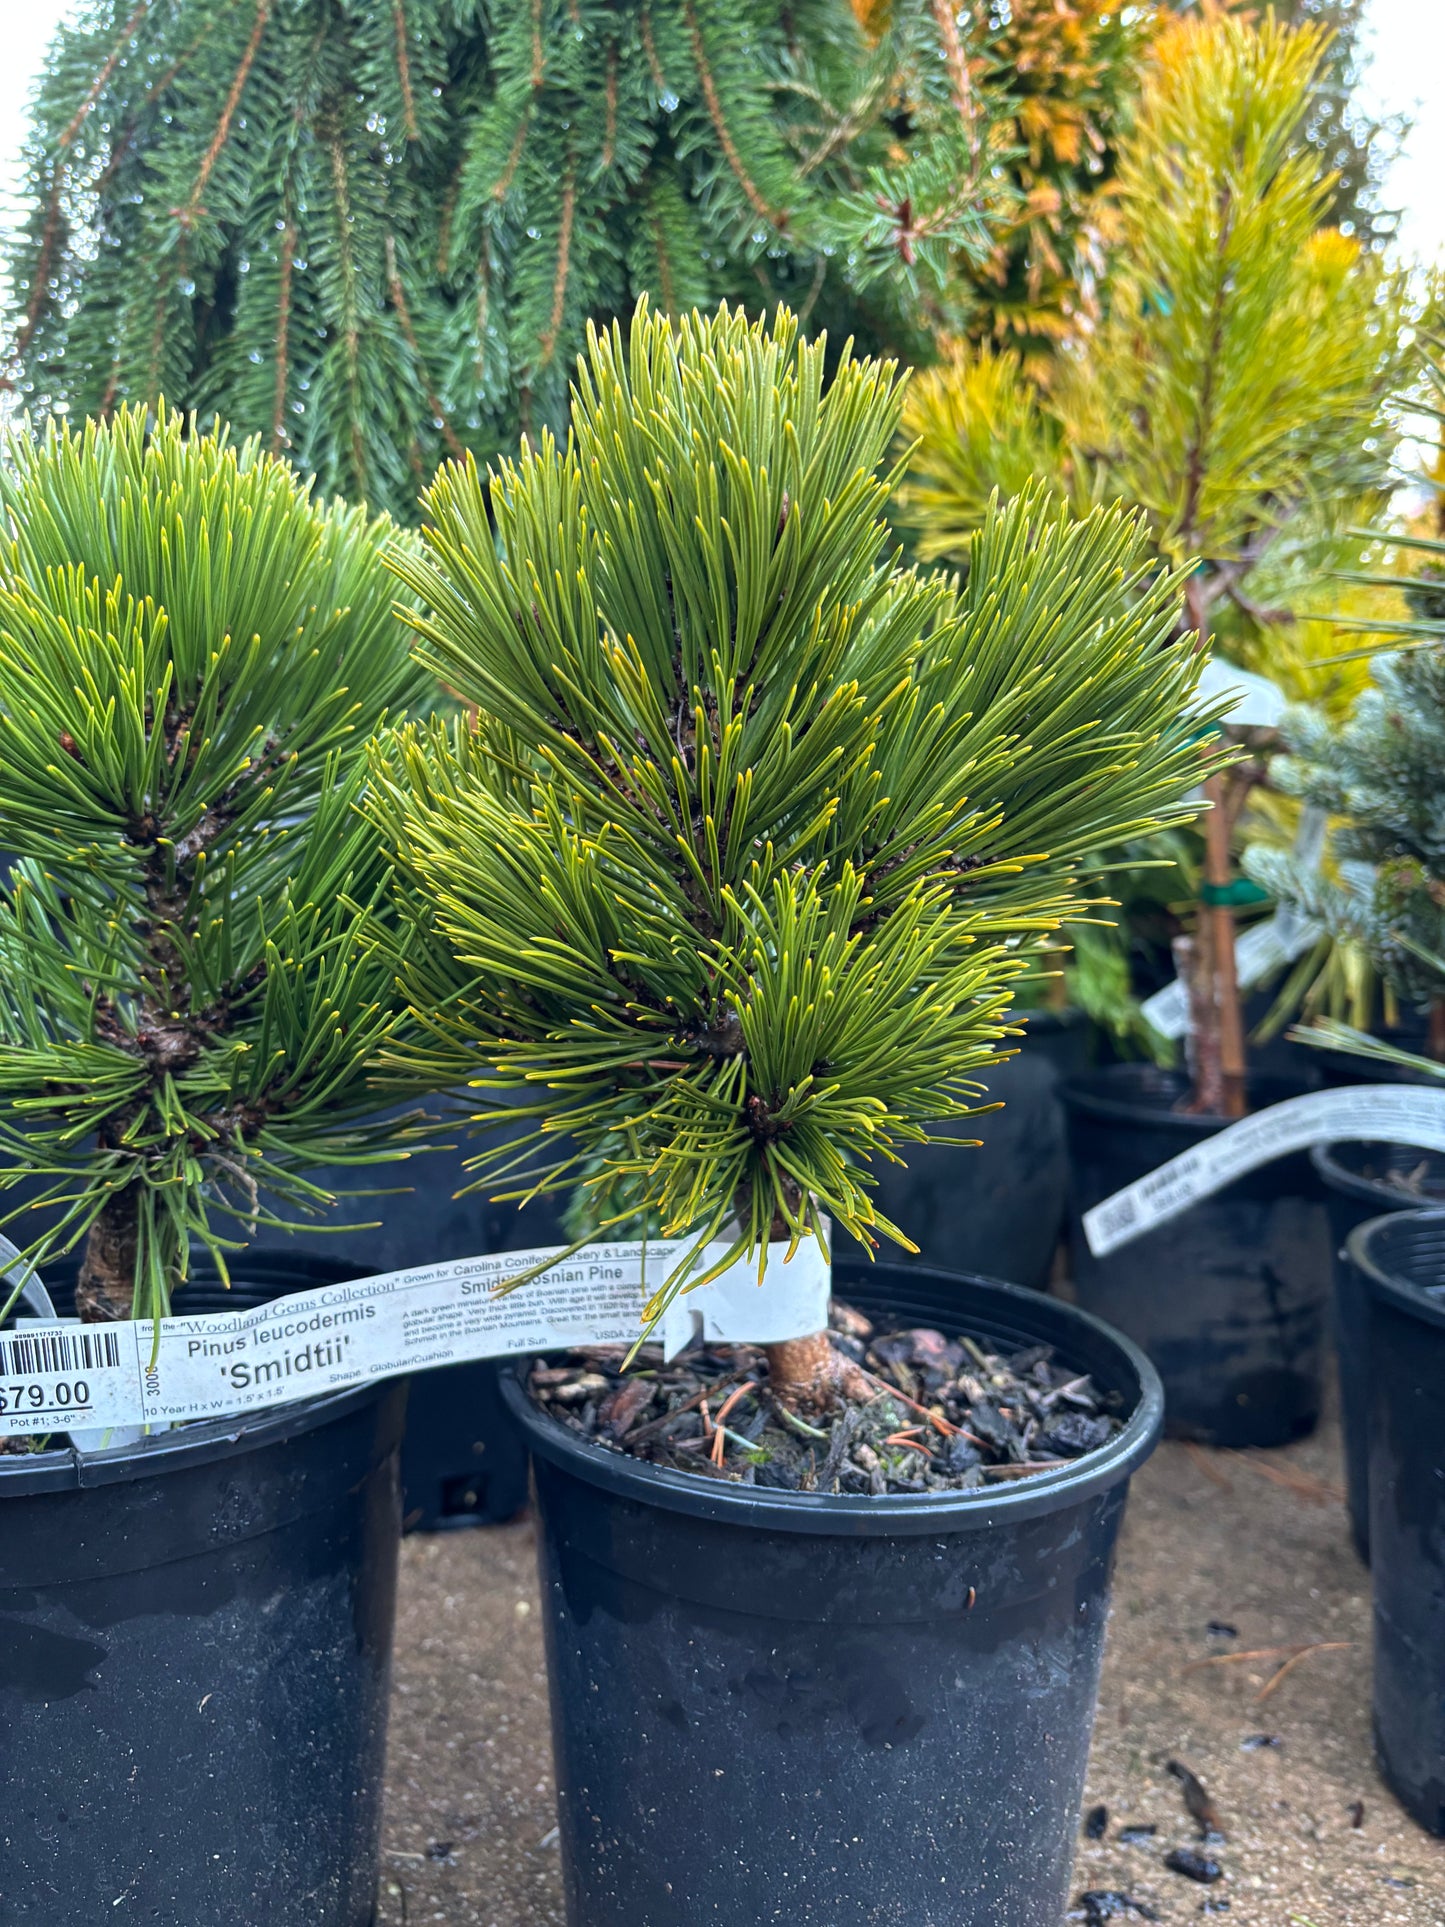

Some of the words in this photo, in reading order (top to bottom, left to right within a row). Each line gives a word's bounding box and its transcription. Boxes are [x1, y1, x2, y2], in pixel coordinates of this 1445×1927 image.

[163, 1323, 175, 1331] the
[272, 1300, 317, 1317] Gems
[403, 1271, 435, 1285] Grown
[437, 1269, 449, 1279] for
[454, 1260, 501, 1276] Carolina
[604, 1248, 611, 1258] &
[461, 1272, 515, 1296] Smid
[523, 1269, 584, 1288] osnian
[589, 1265, 623, 1280] Pine
[457, 1298, 494, 1309] miniatur
[616, 1282, 651, 1292] compat
[187, 1336, 247, 1358] Pinus
[253, 1302, 376, 1346] leucodermis
[528, 1336, 547, 1346] Sun
[595, 1329, 625, 1340] USDA
[220, 1334, 350, 1390] 'Smidtii'
[370, 1349, 454, 1374] Globular/Cushion
[10, 1417, 30, 1428] Pot
[32, 1416, 50, 1426] #1;
[53, 1413, 76, 1424] 3-6"
[144, 1407, 158, 1417] 10
[160, 1404, 186, 1415] Year
[190, 1403, 198, 1412] H
[210, 1400, 223, 1408] W
